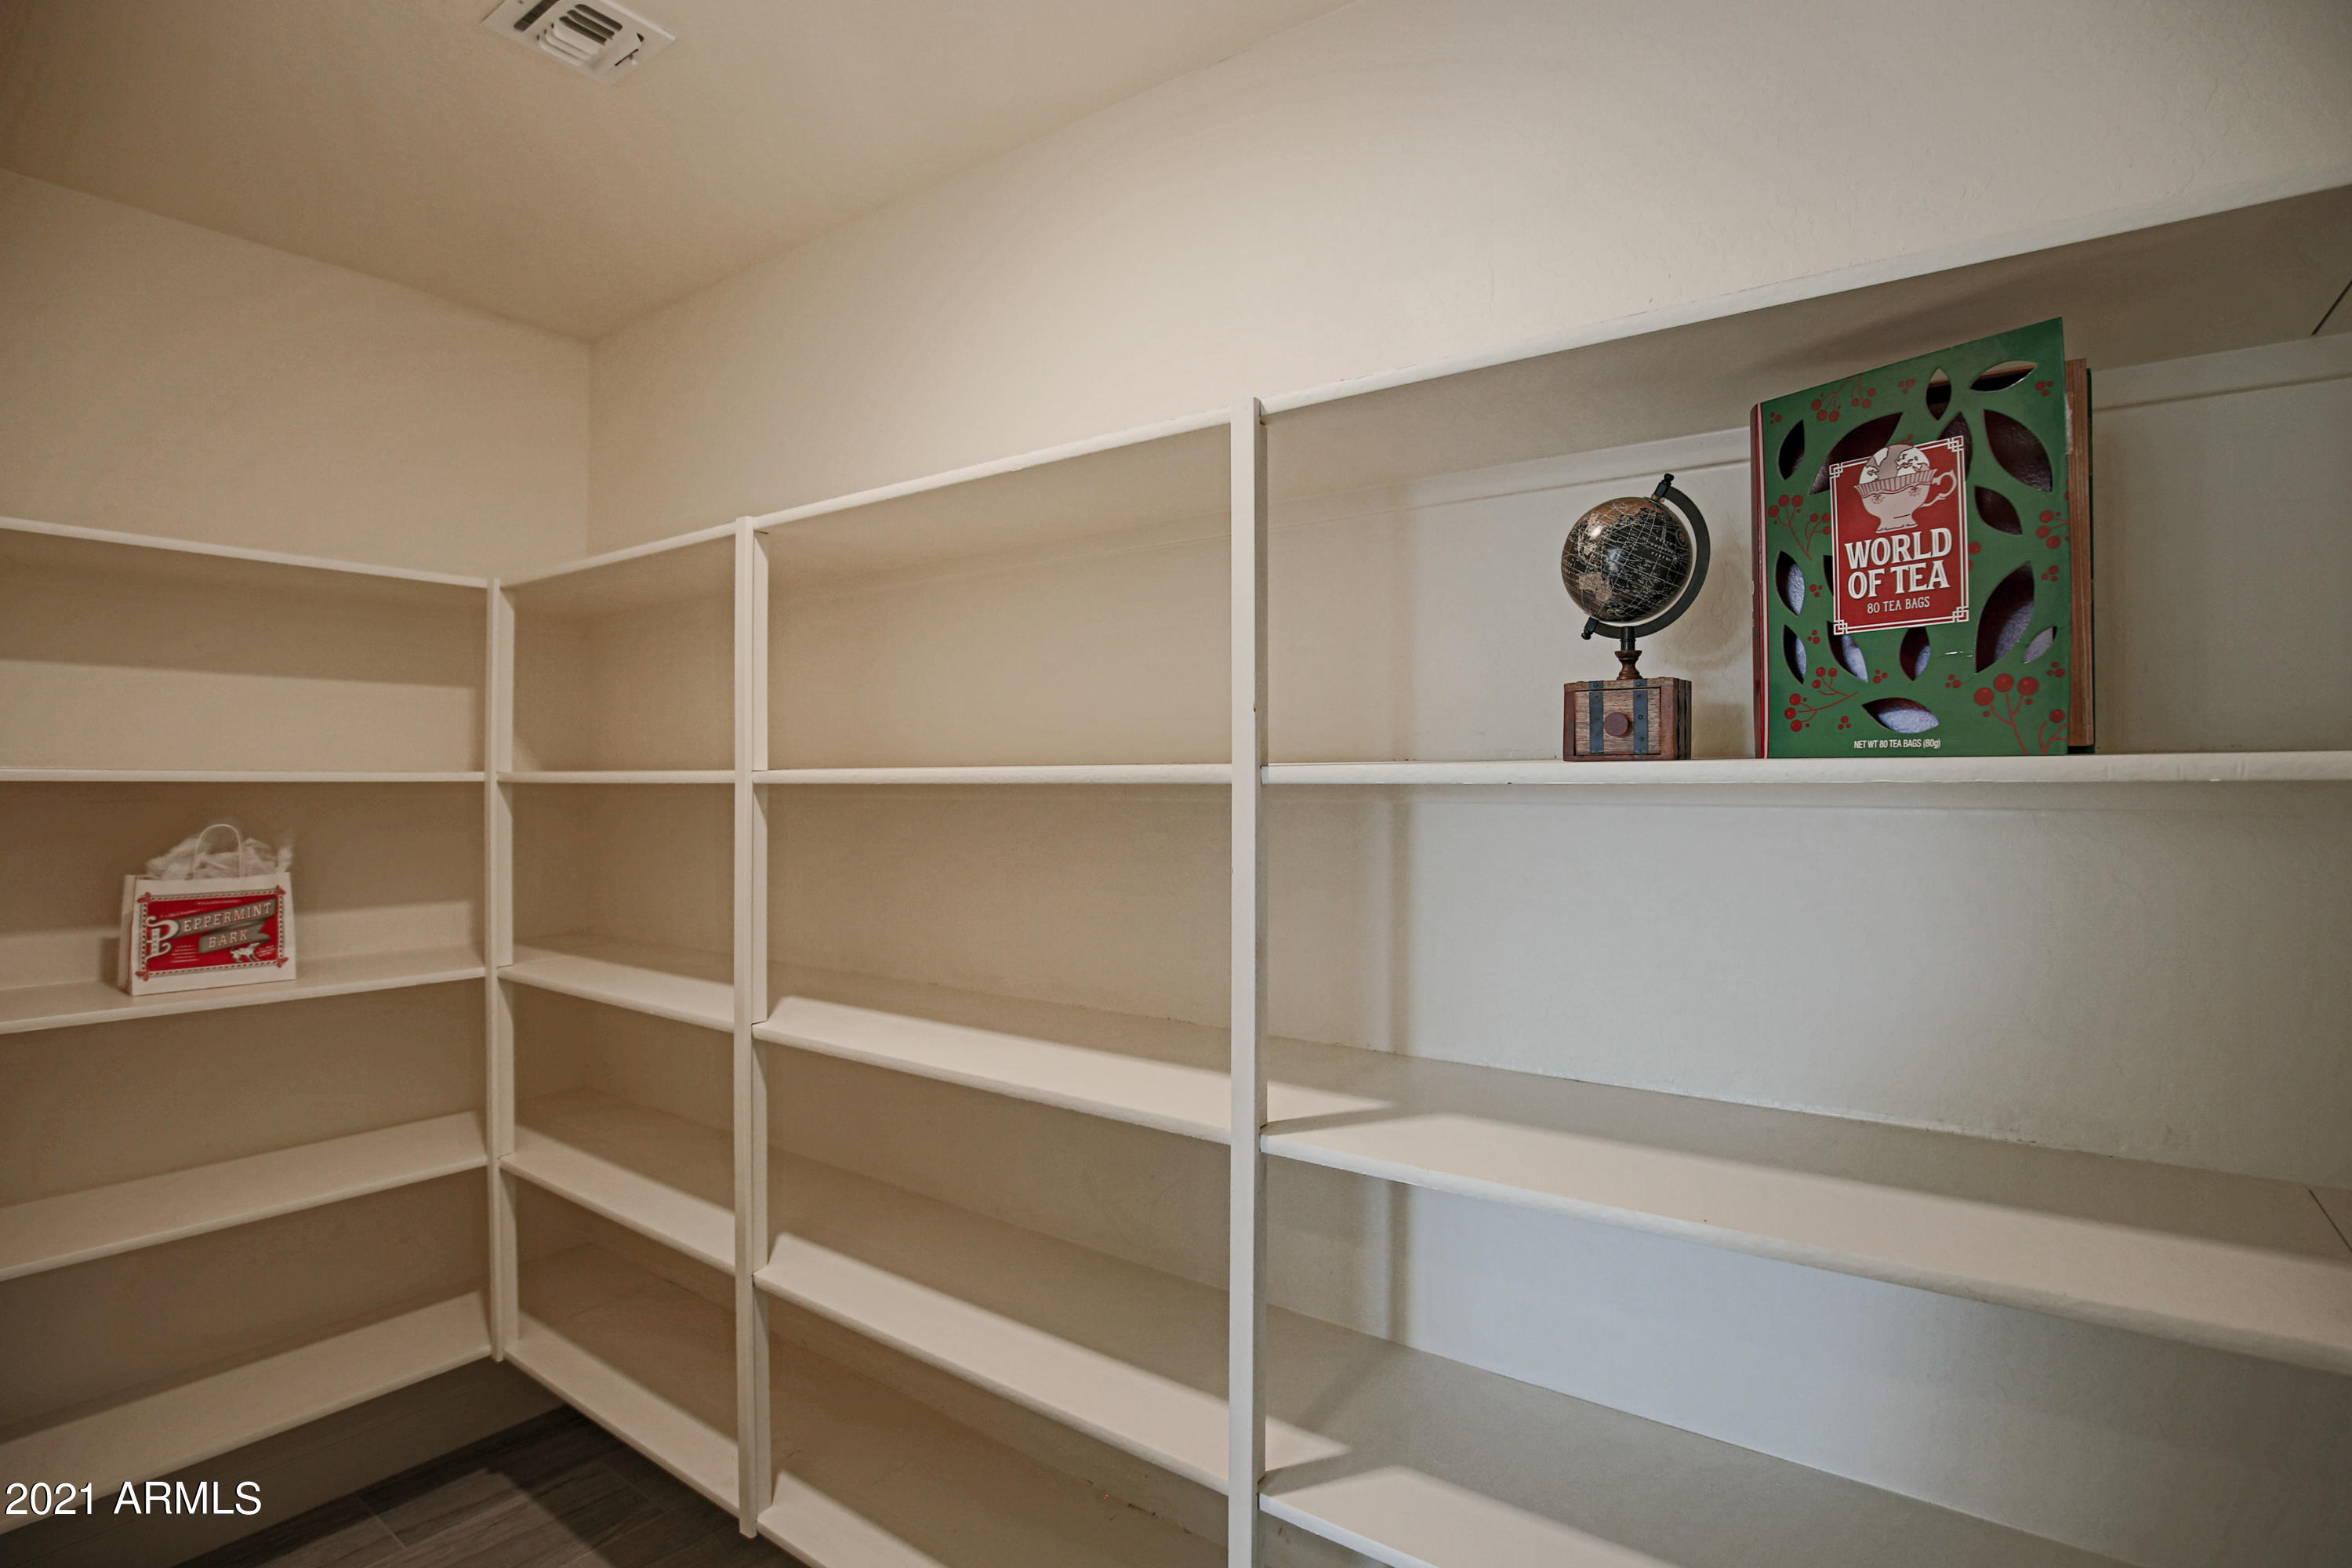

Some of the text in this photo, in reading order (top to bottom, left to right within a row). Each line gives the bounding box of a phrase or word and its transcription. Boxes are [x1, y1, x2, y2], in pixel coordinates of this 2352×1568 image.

[1844, 527, 1952, 569] WORLD
[1848, 559, 1951, 599] OF TEA
[1867, 596, 1930, 614] 80 TEA BAGS
[1853, 739, 1941, 749] NET WT 80 TEA BAGS (80g)
[146, 902, 271, 964] PEPPERMINT
[209, 929, 249, 949] BARK
